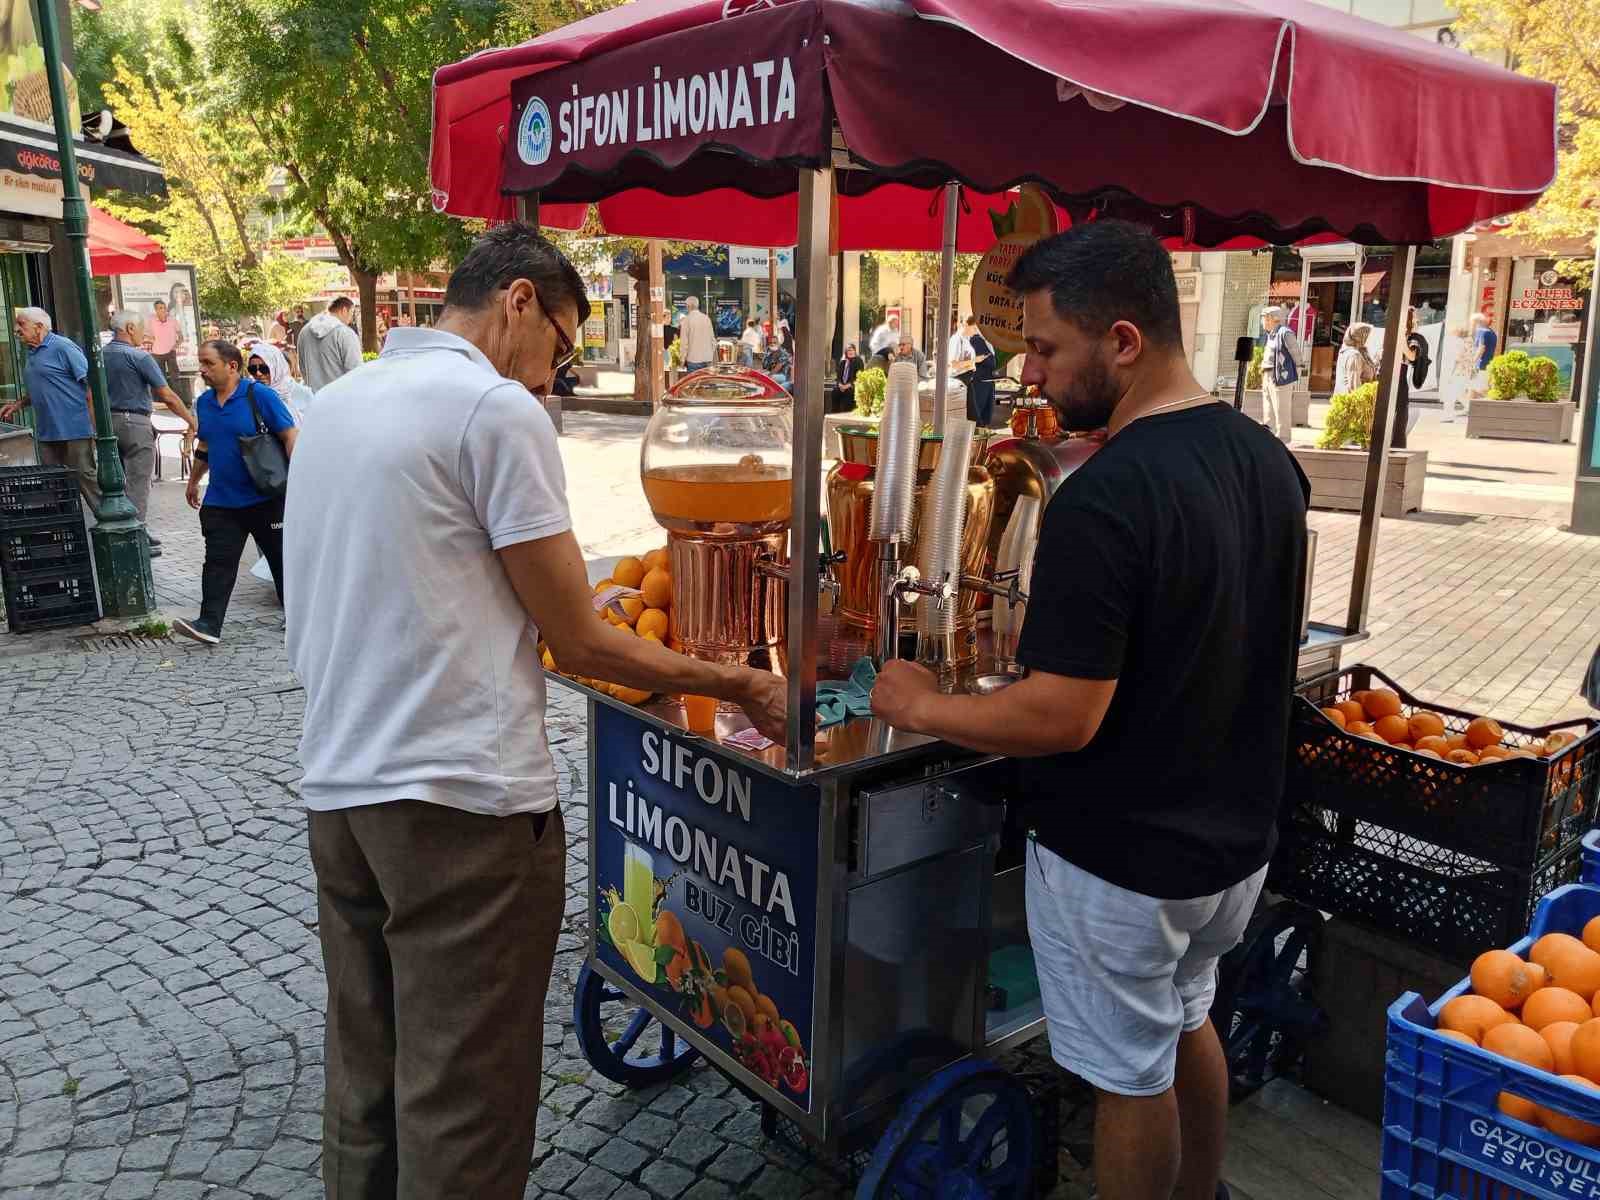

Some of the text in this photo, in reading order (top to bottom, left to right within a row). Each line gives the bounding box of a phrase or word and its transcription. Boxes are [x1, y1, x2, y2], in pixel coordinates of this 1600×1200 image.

[559, 56, 796, 154] SİFON LİMONATA
[641, 729, 752, 823] SİFON
[608, 779, 797, 927] LİMONATA
[684, 879, 734, 936] BUZ
